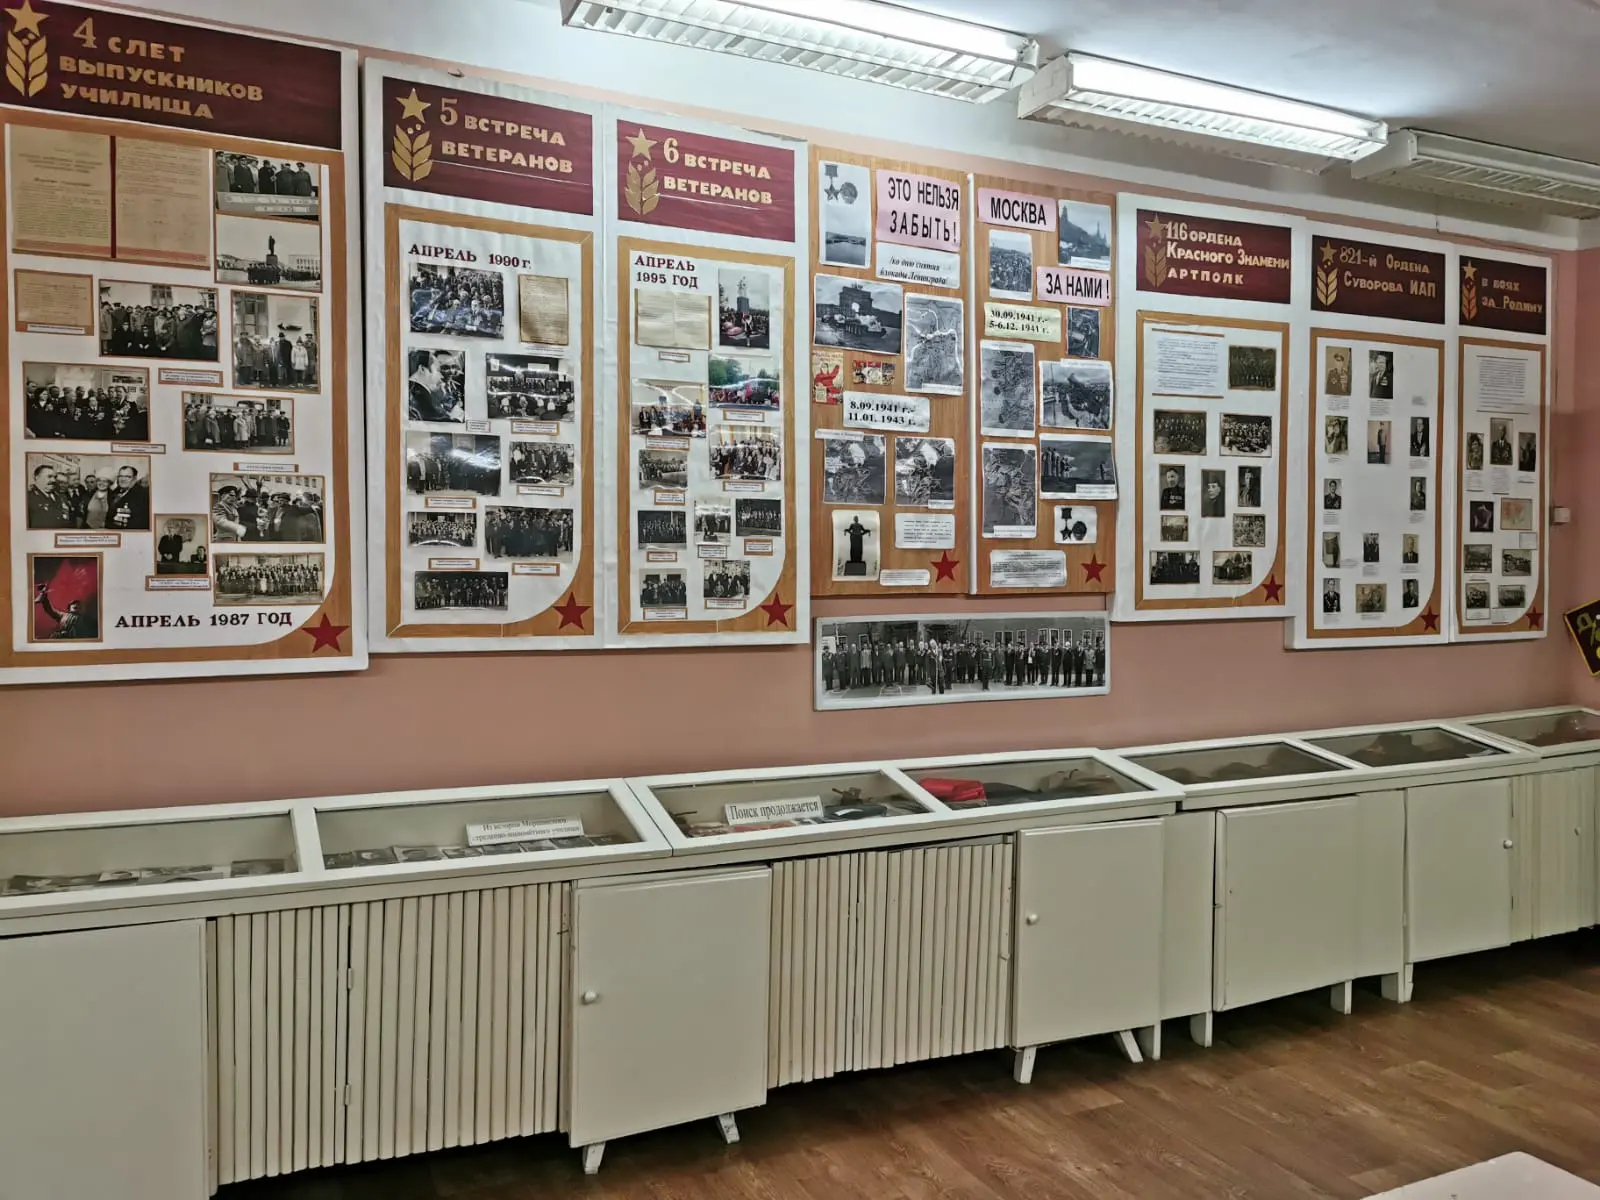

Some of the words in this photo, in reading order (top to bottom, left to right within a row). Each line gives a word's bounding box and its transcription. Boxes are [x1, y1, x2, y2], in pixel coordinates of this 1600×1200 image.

[73, 17, 97, 49] 4
[108, 36, 185, 63] СЛЕТ
[59, 55, 264, 101] ВЫПУСКНИКОВ
[60, 83, 214, 120] УЧИЛИЩА
[440, 97, 458, 126] 5
[465, 114, 566, 146] ВСТРЕЧА
[441, 140, 573, 173] ВЕТЕРАНОВ
[663, 137, 679, 164] 6
[684, 153, 771, 180] ВСТРЕЧА
[663, 175, 772, 204] ВЕТЕРАНОВ
[888, 177, 911, 201] ЭТО
[917, 181, 959, 211] НЕЛЬЗЯ
[990, 197, 1046, 226] МОСКВА
[1164, 220, 1188, 241] 116
[1189, 230, 1242, 247] ОРДЕНА
[408, 243, 477, 262] АПРЕЛЬ
[489, 253, 520, 268] 1990
[634, 255, 695, 272] АПРЕЛЬ
[636, 271, 667, 284] 1995
[672, 274, 698, 289] ГОД
[1045, 273, 1063, 295] ЗА
[1066, 275, 1102, 299] НАМИ
[1167, 267, 1244, 285] АРТПОЛК
[1410, 279, 1436, 299] ИАП
[115, 615, 200, 628] АПРЕЛЬ
[210, 613, 249, 626] 1987
[257, 612, 292, 626] ГОД
[730, 805, 759, 820] Поиск
[760, 801, 819, 820] продолжается
